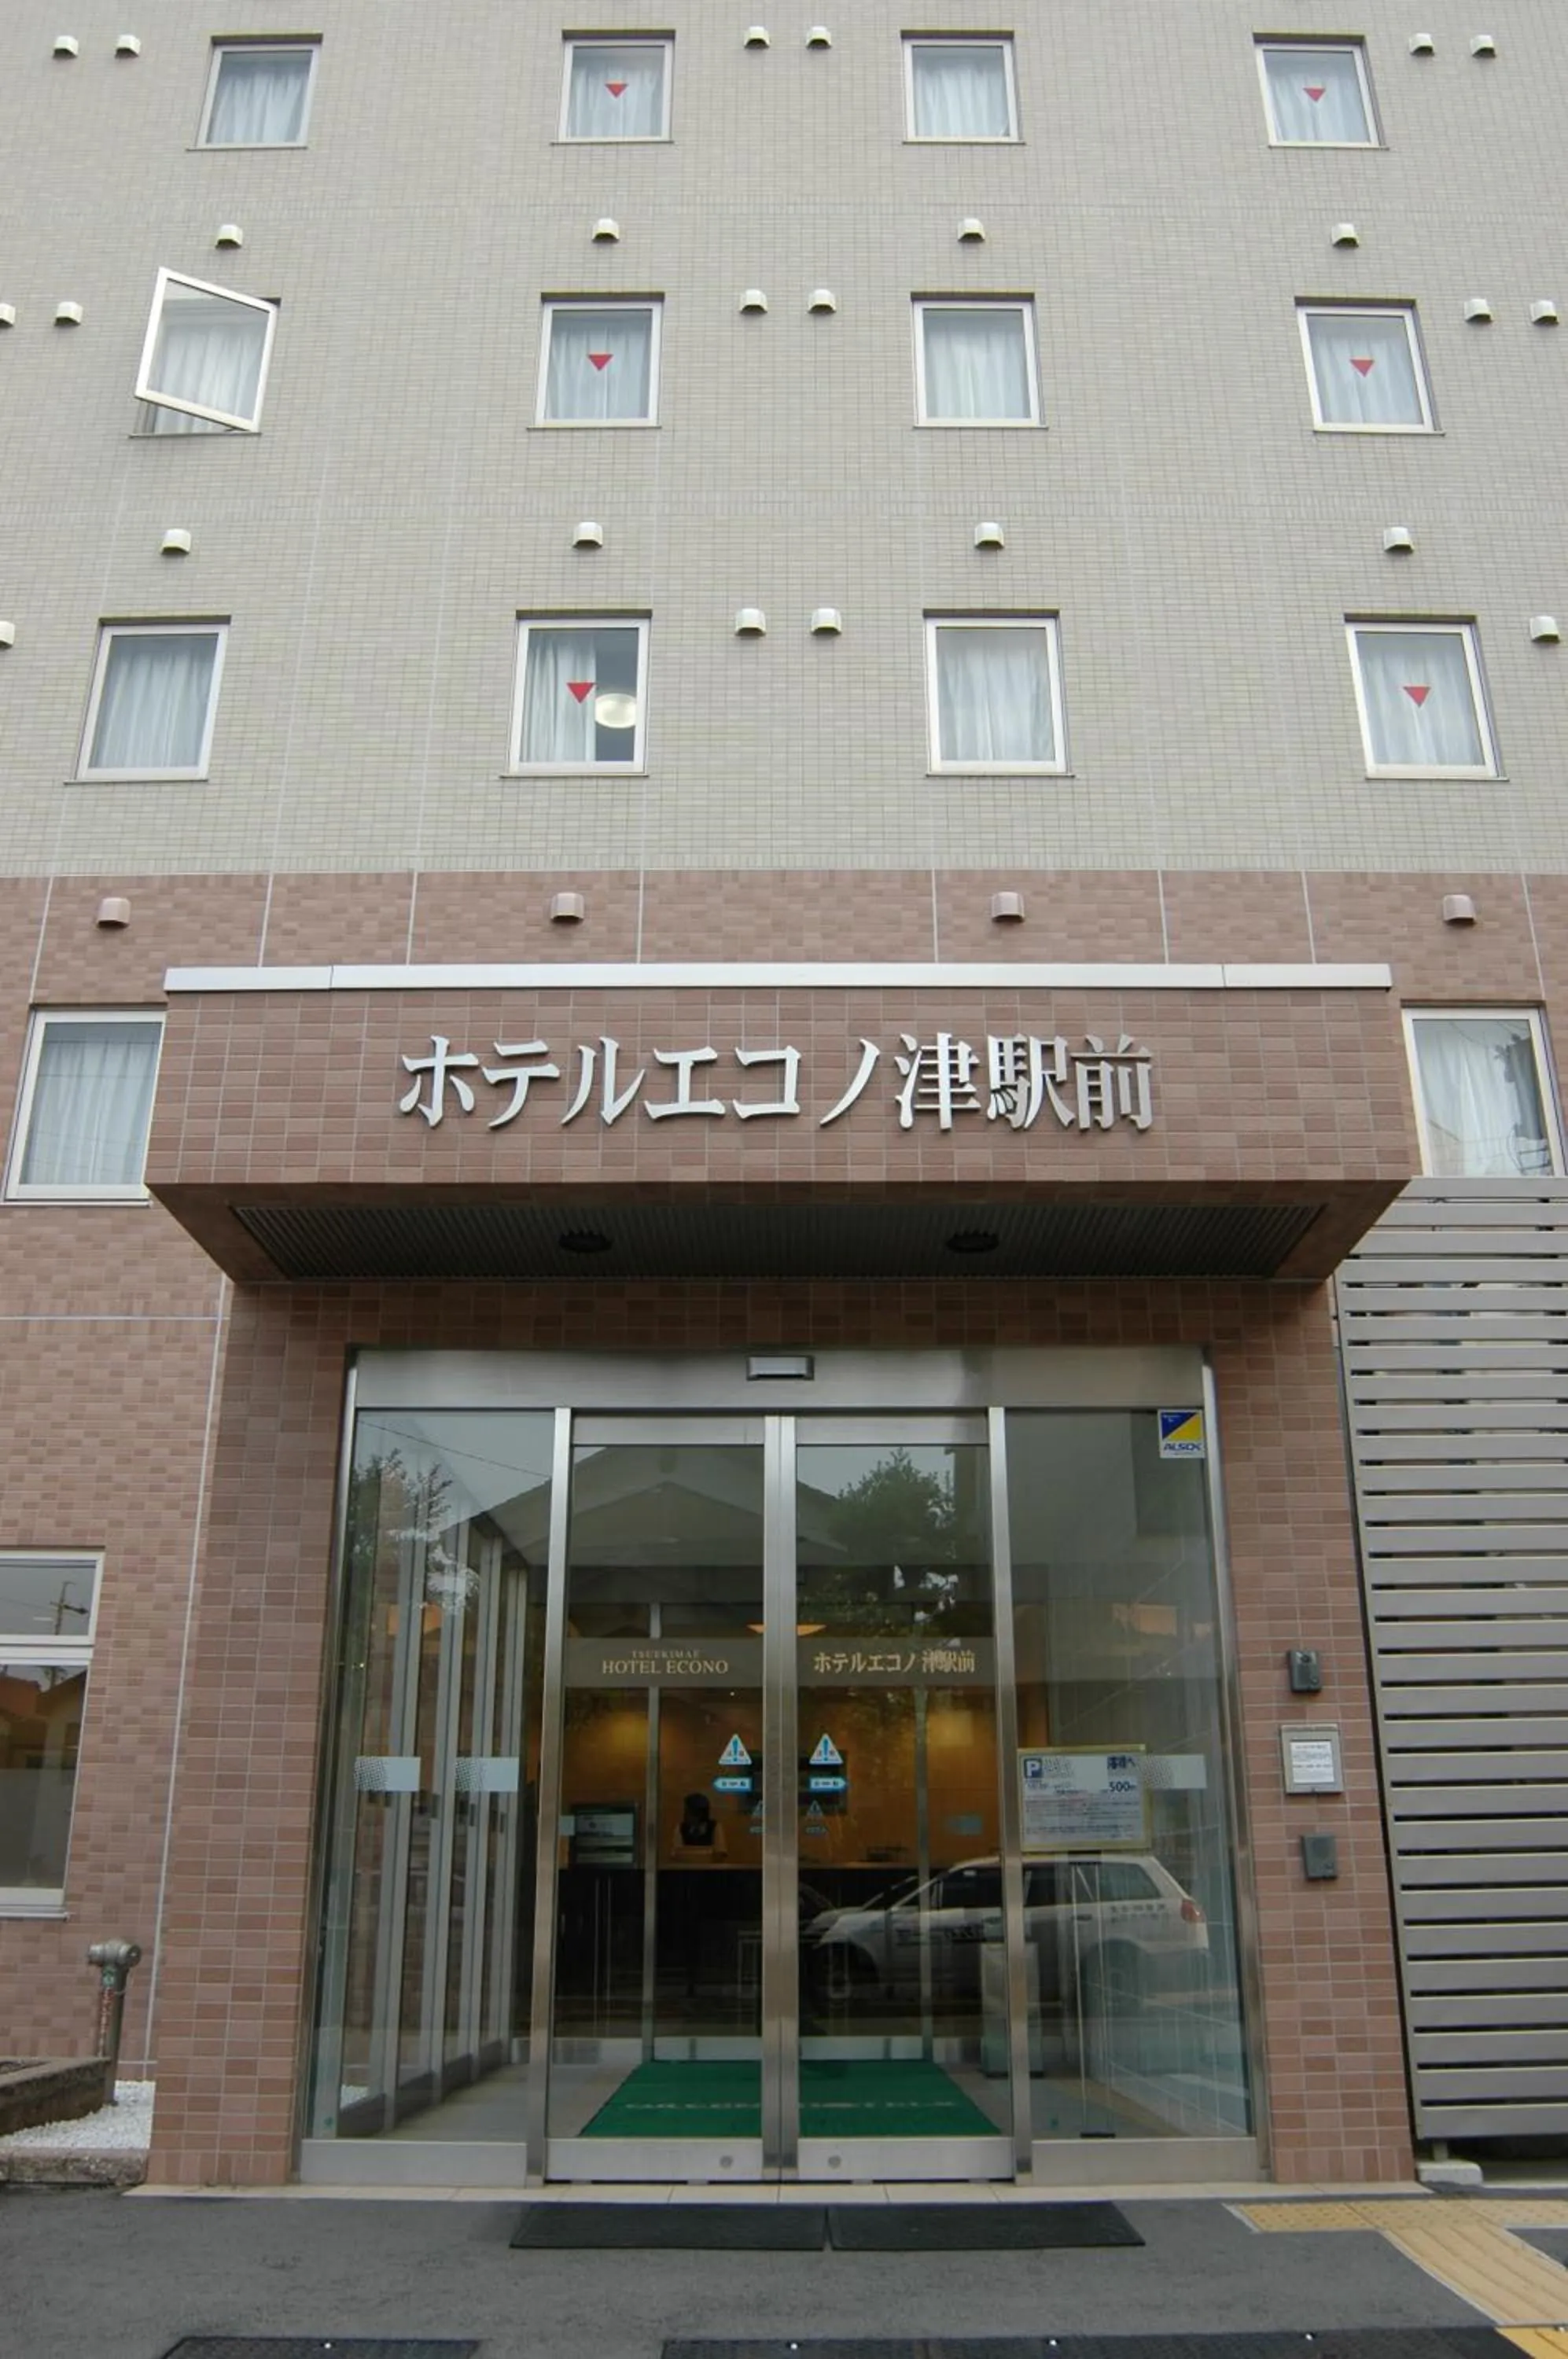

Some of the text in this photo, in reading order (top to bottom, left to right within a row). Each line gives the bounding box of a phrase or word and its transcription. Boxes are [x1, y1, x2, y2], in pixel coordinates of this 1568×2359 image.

[399, 1032, 1155, 1132] ホテルエコノ津駅前
[602, 1659, 728, 1674] HOTEL ECONO
